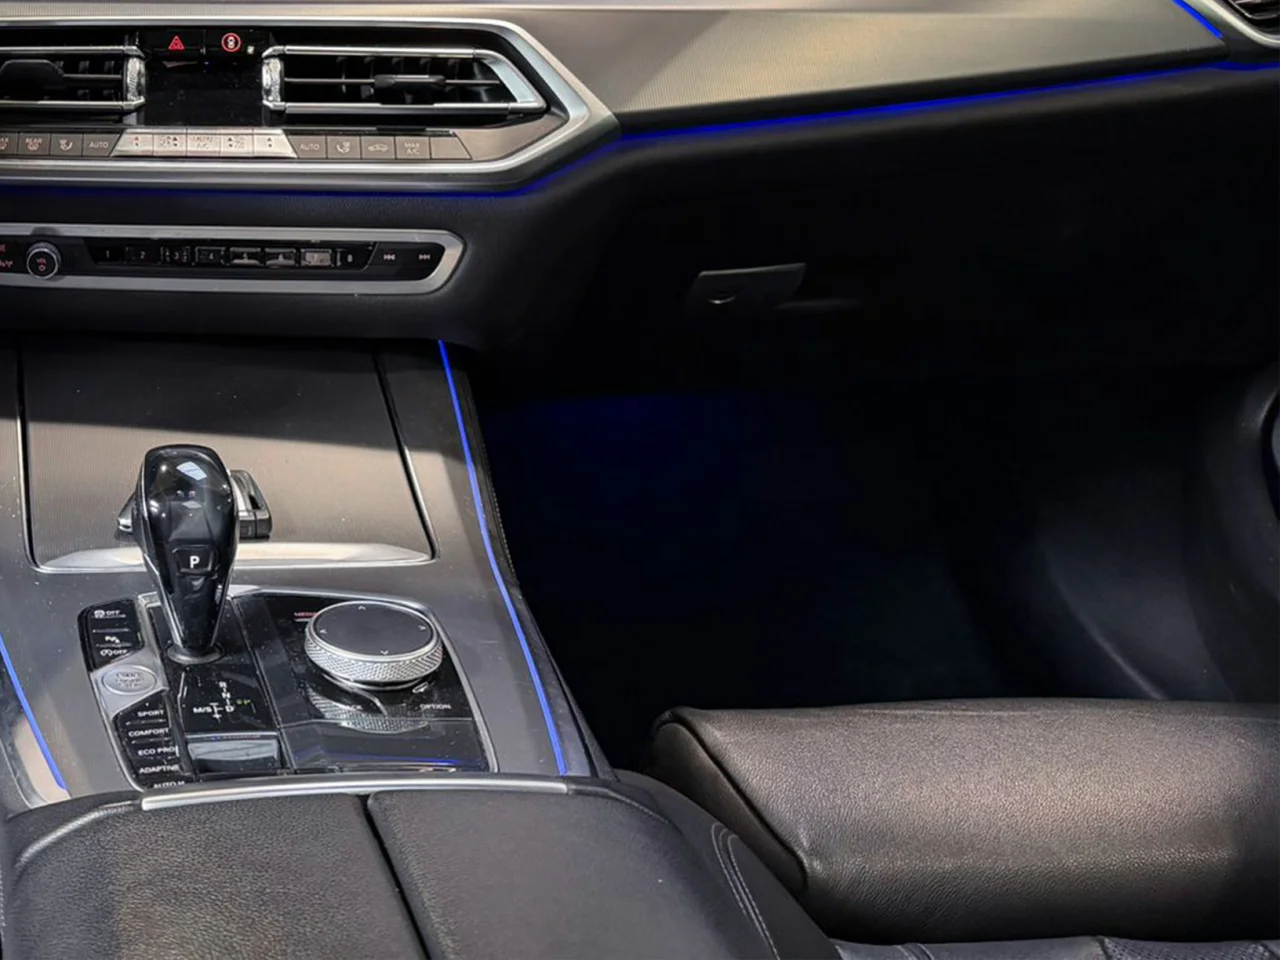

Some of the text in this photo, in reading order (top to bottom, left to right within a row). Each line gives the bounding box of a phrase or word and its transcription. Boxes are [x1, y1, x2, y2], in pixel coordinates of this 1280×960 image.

[88, 141, 109, 149] AUTO
[299, 143, 320, 151] AUTO
[190, 555, 201, 569] P
[138, 709, 164, 718] SPORT
[128, 727, 169, 737] COMFORT
[138, 745, 175, 756] ECO PRO
[139, 764, 179, 774] ADAPTIVE
